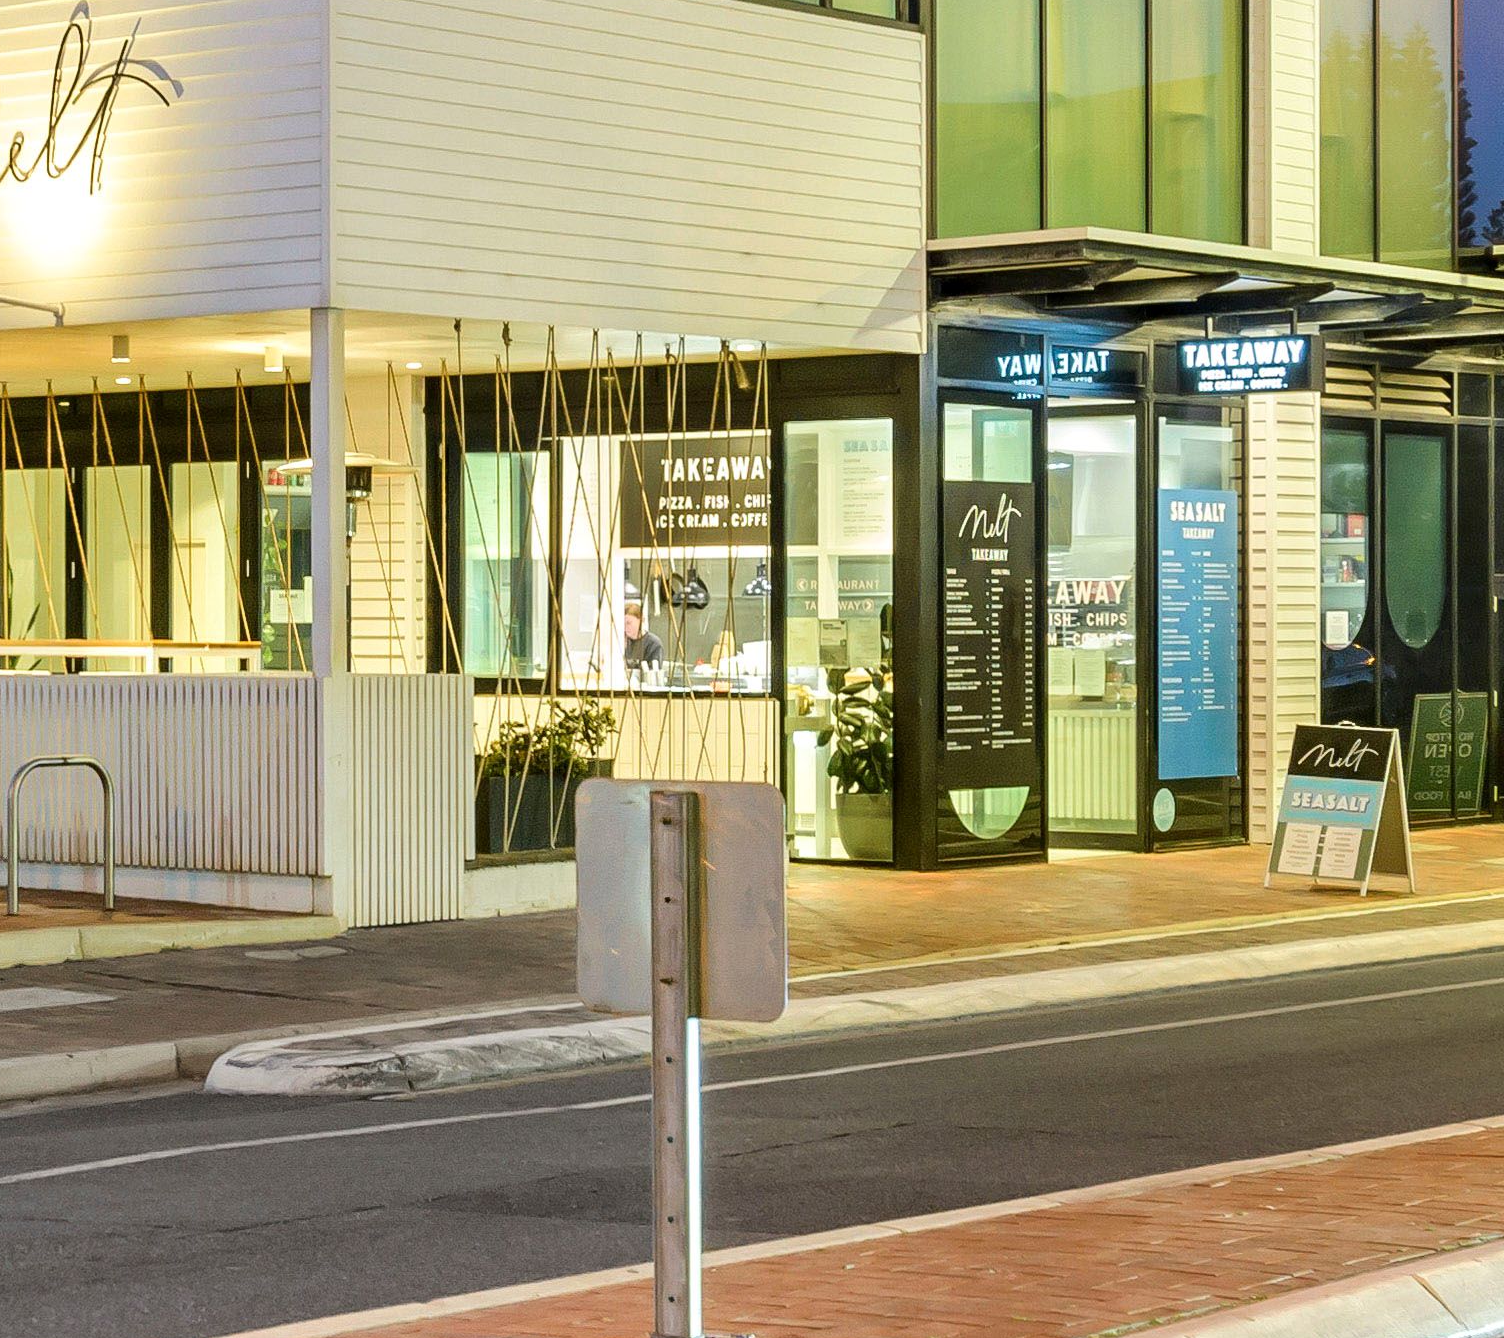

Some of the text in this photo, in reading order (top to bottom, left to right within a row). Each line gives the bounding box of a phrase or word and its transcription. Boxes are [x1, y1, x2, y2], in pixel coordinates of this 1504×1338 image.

[1183, 340, 1304, 368] TAKEAWAY
[731, 513, 768, 528] COFFE
[971, 548, 1009, 561] TAKEAWAY
[1086, 612, 1128, 627] CHIPS
[1291, 791, 1370, 813] SEASALT
